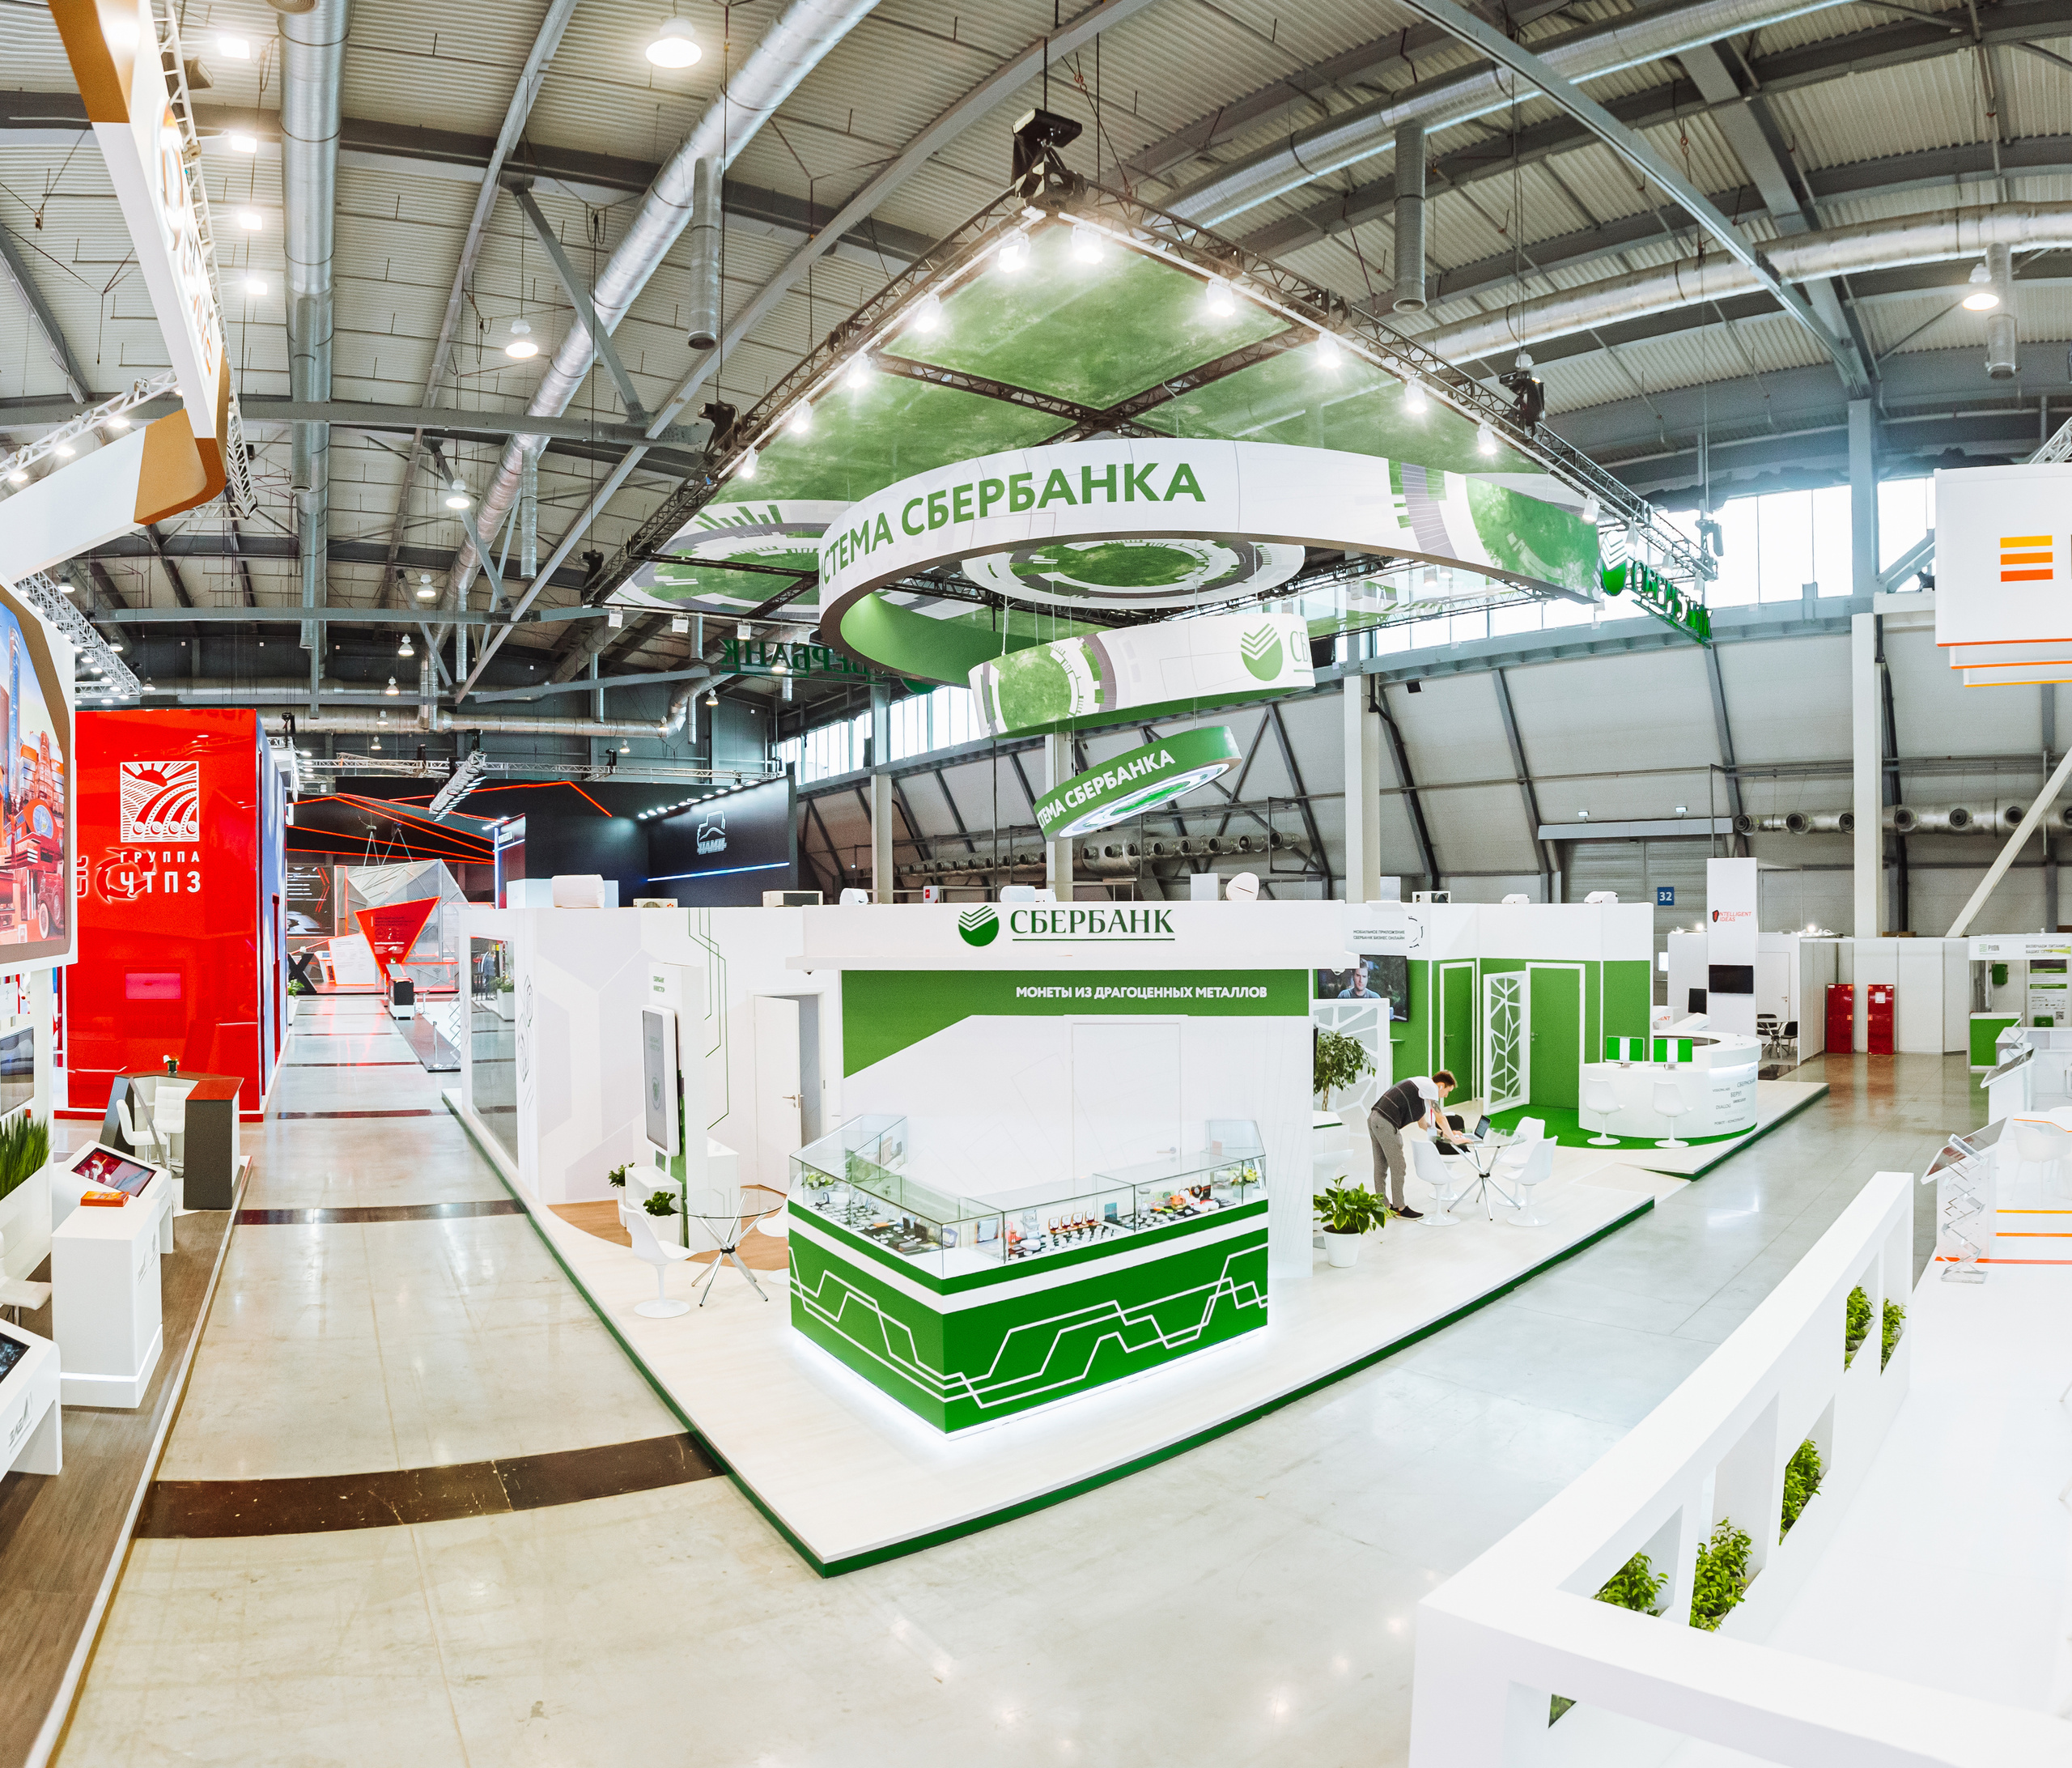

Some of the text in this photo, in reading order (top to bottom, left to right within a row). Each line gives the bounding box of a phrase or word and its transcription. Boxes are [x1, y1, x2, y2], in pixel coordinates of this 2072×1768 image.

[902, 462, 1206, 535] СБЕРБАНКА
[1065, 750, 1175, 808] СБЕРБАНКА
[121, 851, 200, 863] ГРУППА
[121, 871, 201, 893] ЧТПЗ
[1659, 891, 1672, 901] 32
[1010, 908, 1175, 934] СБЕРБАНК
[1016, 987, 1267, 1000] МОНЕТЫ ИЗ ДРАГОЦЕННЫХ МЕТАЛЛОВ
